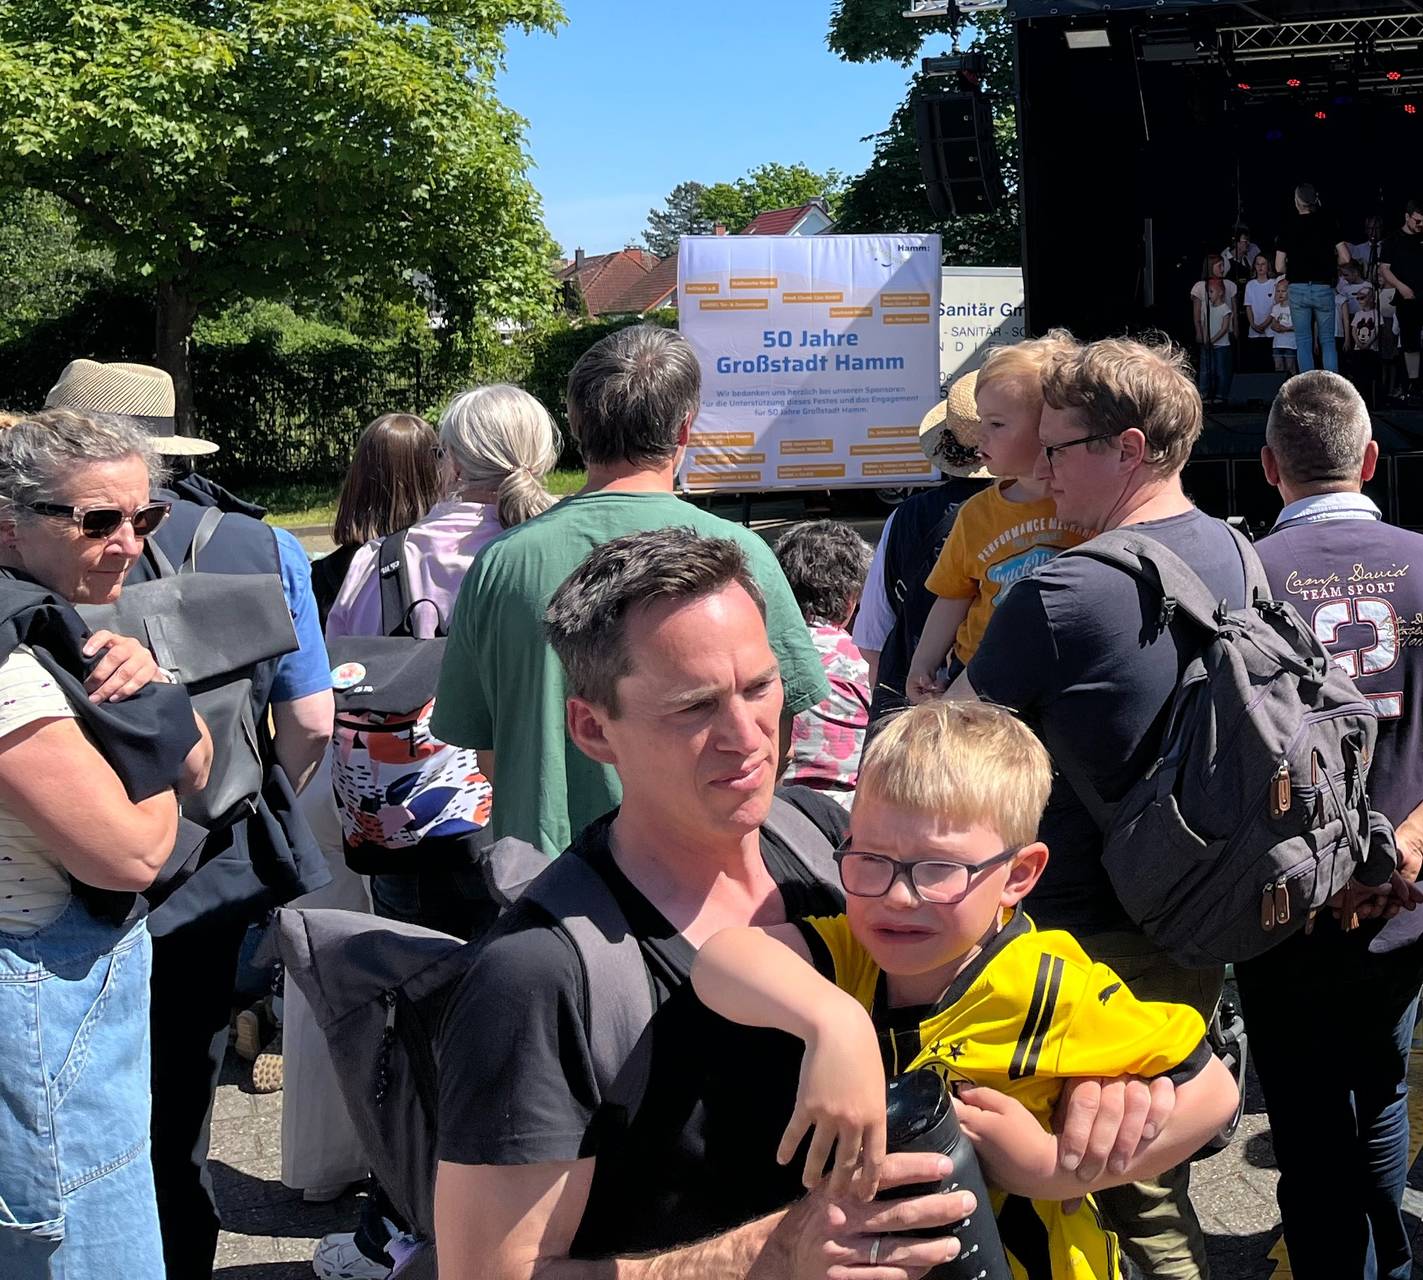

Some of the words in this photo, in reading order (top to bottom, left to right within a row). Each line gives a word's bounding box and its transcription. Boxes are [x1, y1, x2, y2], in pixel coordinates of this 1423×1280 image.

[939, 302, 994, 317] Sanitär
[763, 331, 792, 348] 50
[799, 329, 858, 347] Jahre
[951, 324, 1001, 337] SANITÄR
[717, 354, 828, 374] Großstadt
[836, 354, 904, 371] Hamm
[715, 399, 728, 407] die
[813, 397, 838, 405] Festes
[872, 395, 919, 403] Engagement
[732, 389, 770, 397] bedanken
[788, 387, 818, 396] herzlich
[833, 386, 863, 394] unseren
[865, 386, 906, 394] Sponsoren
[977, 517, 1046, 563] PERFORMANCE
[1285, 571, 1340, 594] Camp
[1347, 562, 1409, 581] David
[1300, 586, 1342, 601] TEAM
[1347, 582, 1395, 596] SPORT
